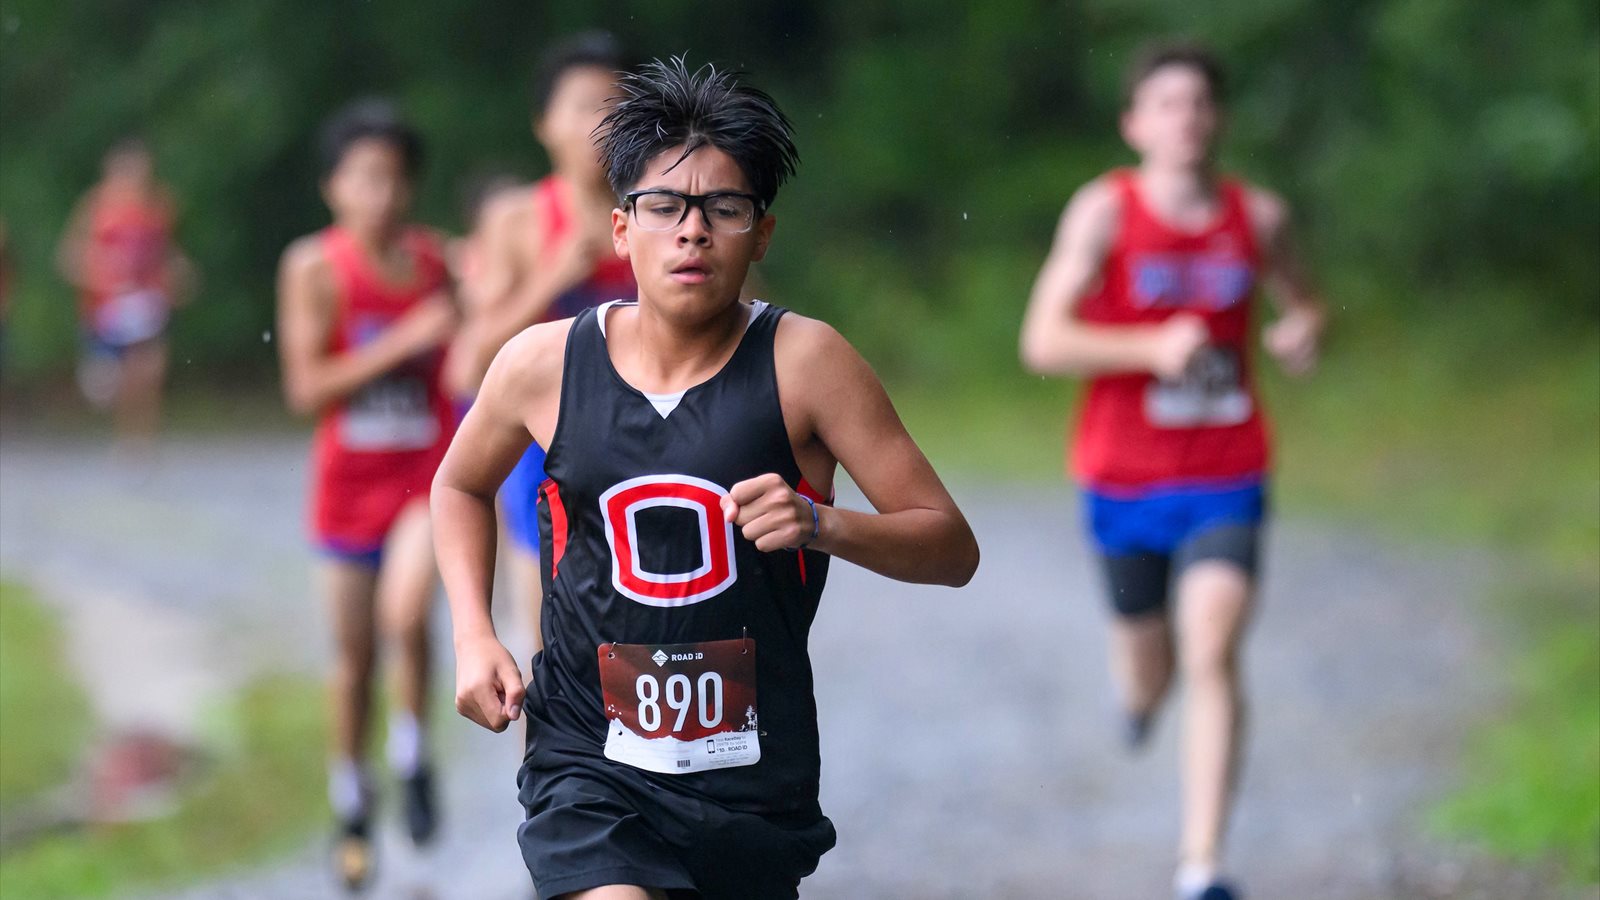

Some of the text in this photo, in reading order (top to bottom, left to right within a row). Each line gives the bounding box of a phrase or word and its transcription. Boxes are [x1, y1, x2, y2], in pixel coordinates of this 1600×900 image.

[599, 474, 737, 607] O
[671, 653, 693, 661] ROAD
[635, 671, 723, 732] 890
